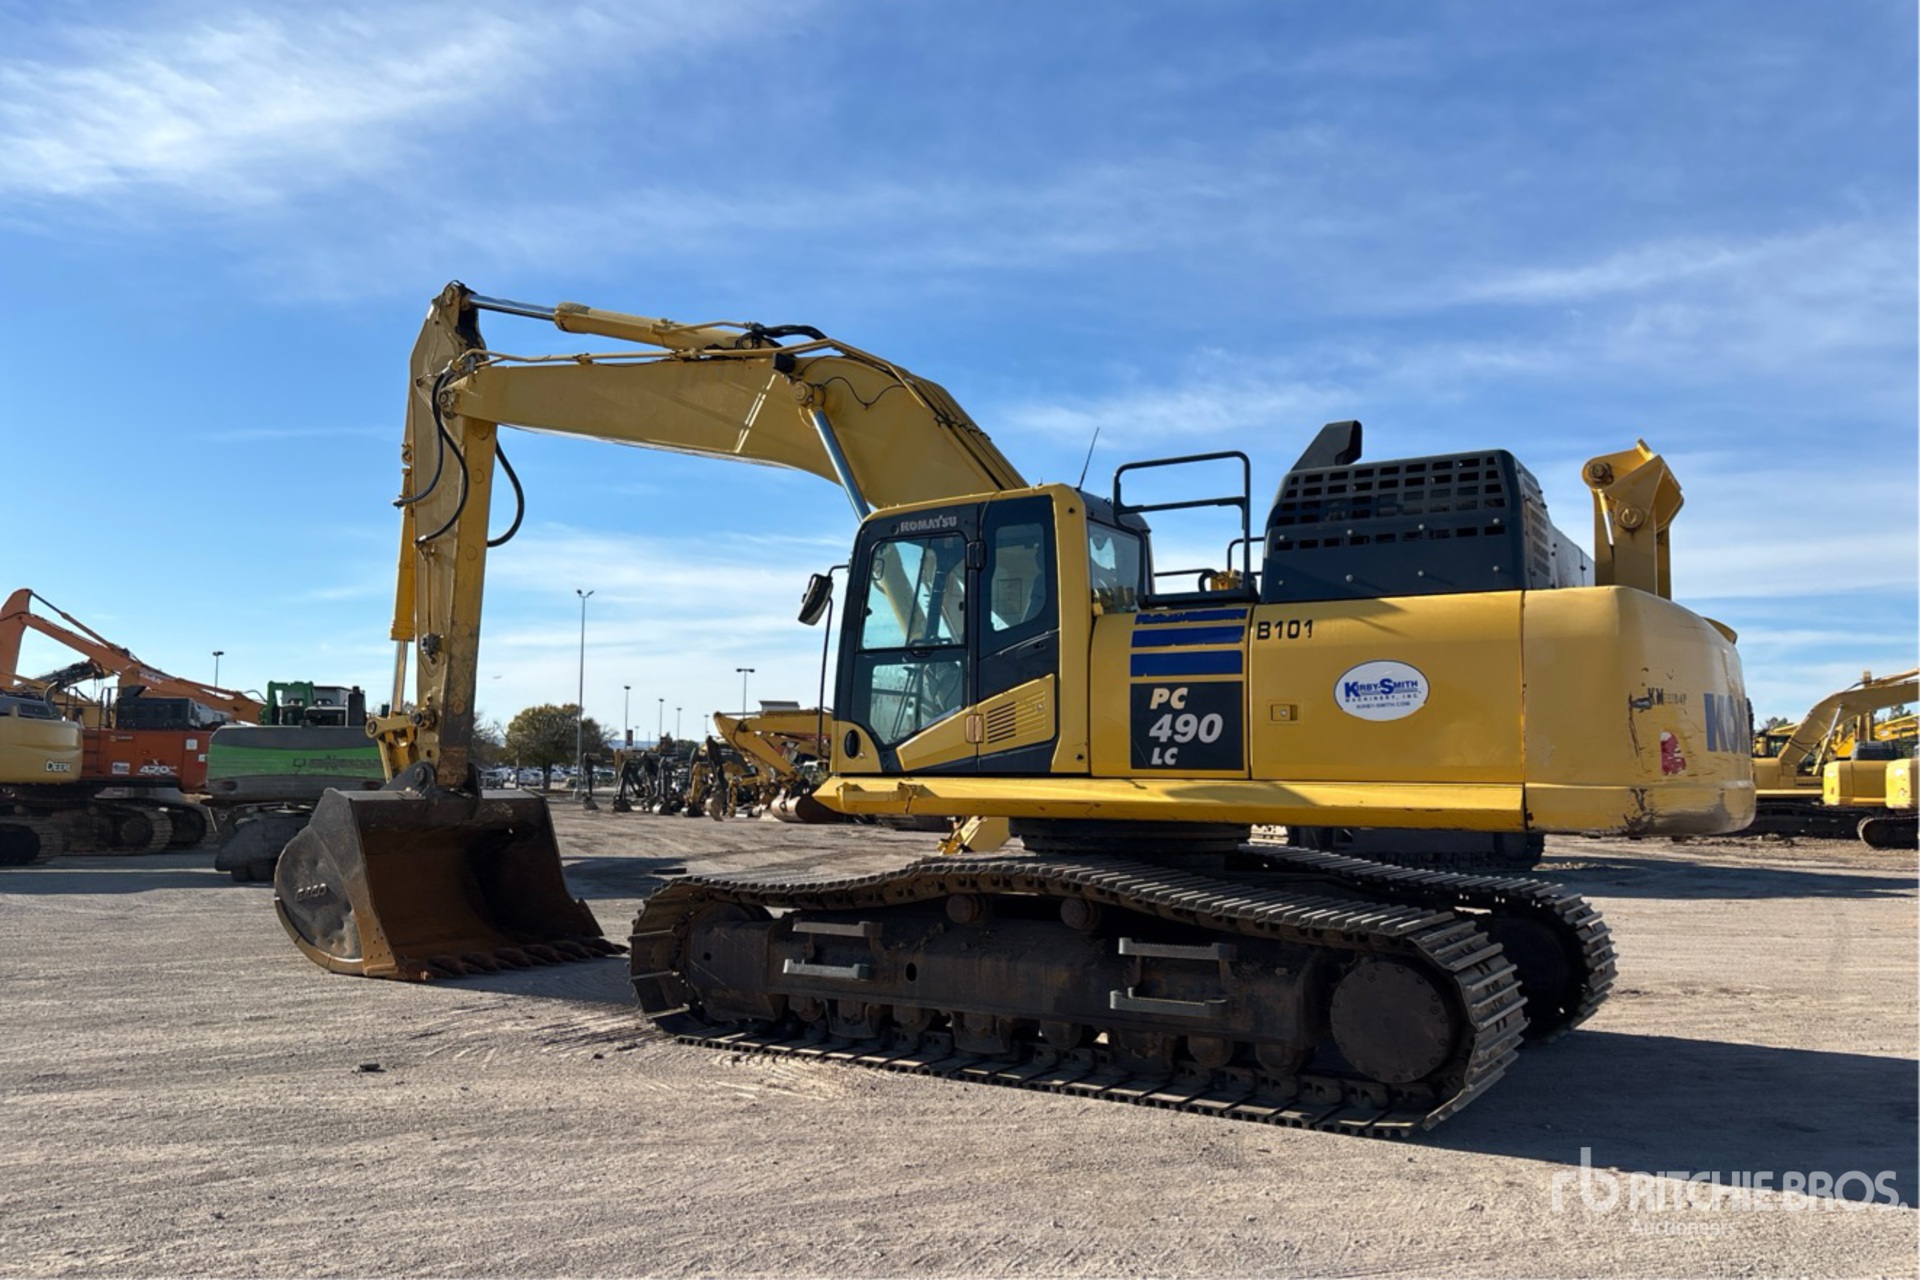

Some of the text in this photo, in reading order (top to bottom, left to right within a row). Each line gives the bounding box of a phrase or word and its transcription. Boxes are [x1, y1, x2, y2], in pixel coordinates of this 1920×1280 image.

[900, 514, 957, 532] KOMATSU
[1256, 619, 1313, 640] B101
[1150, 687, 1188, 709] PC
[1149, 712, 1223, 743] 490
[1151, 747, 1178, 765] LC
